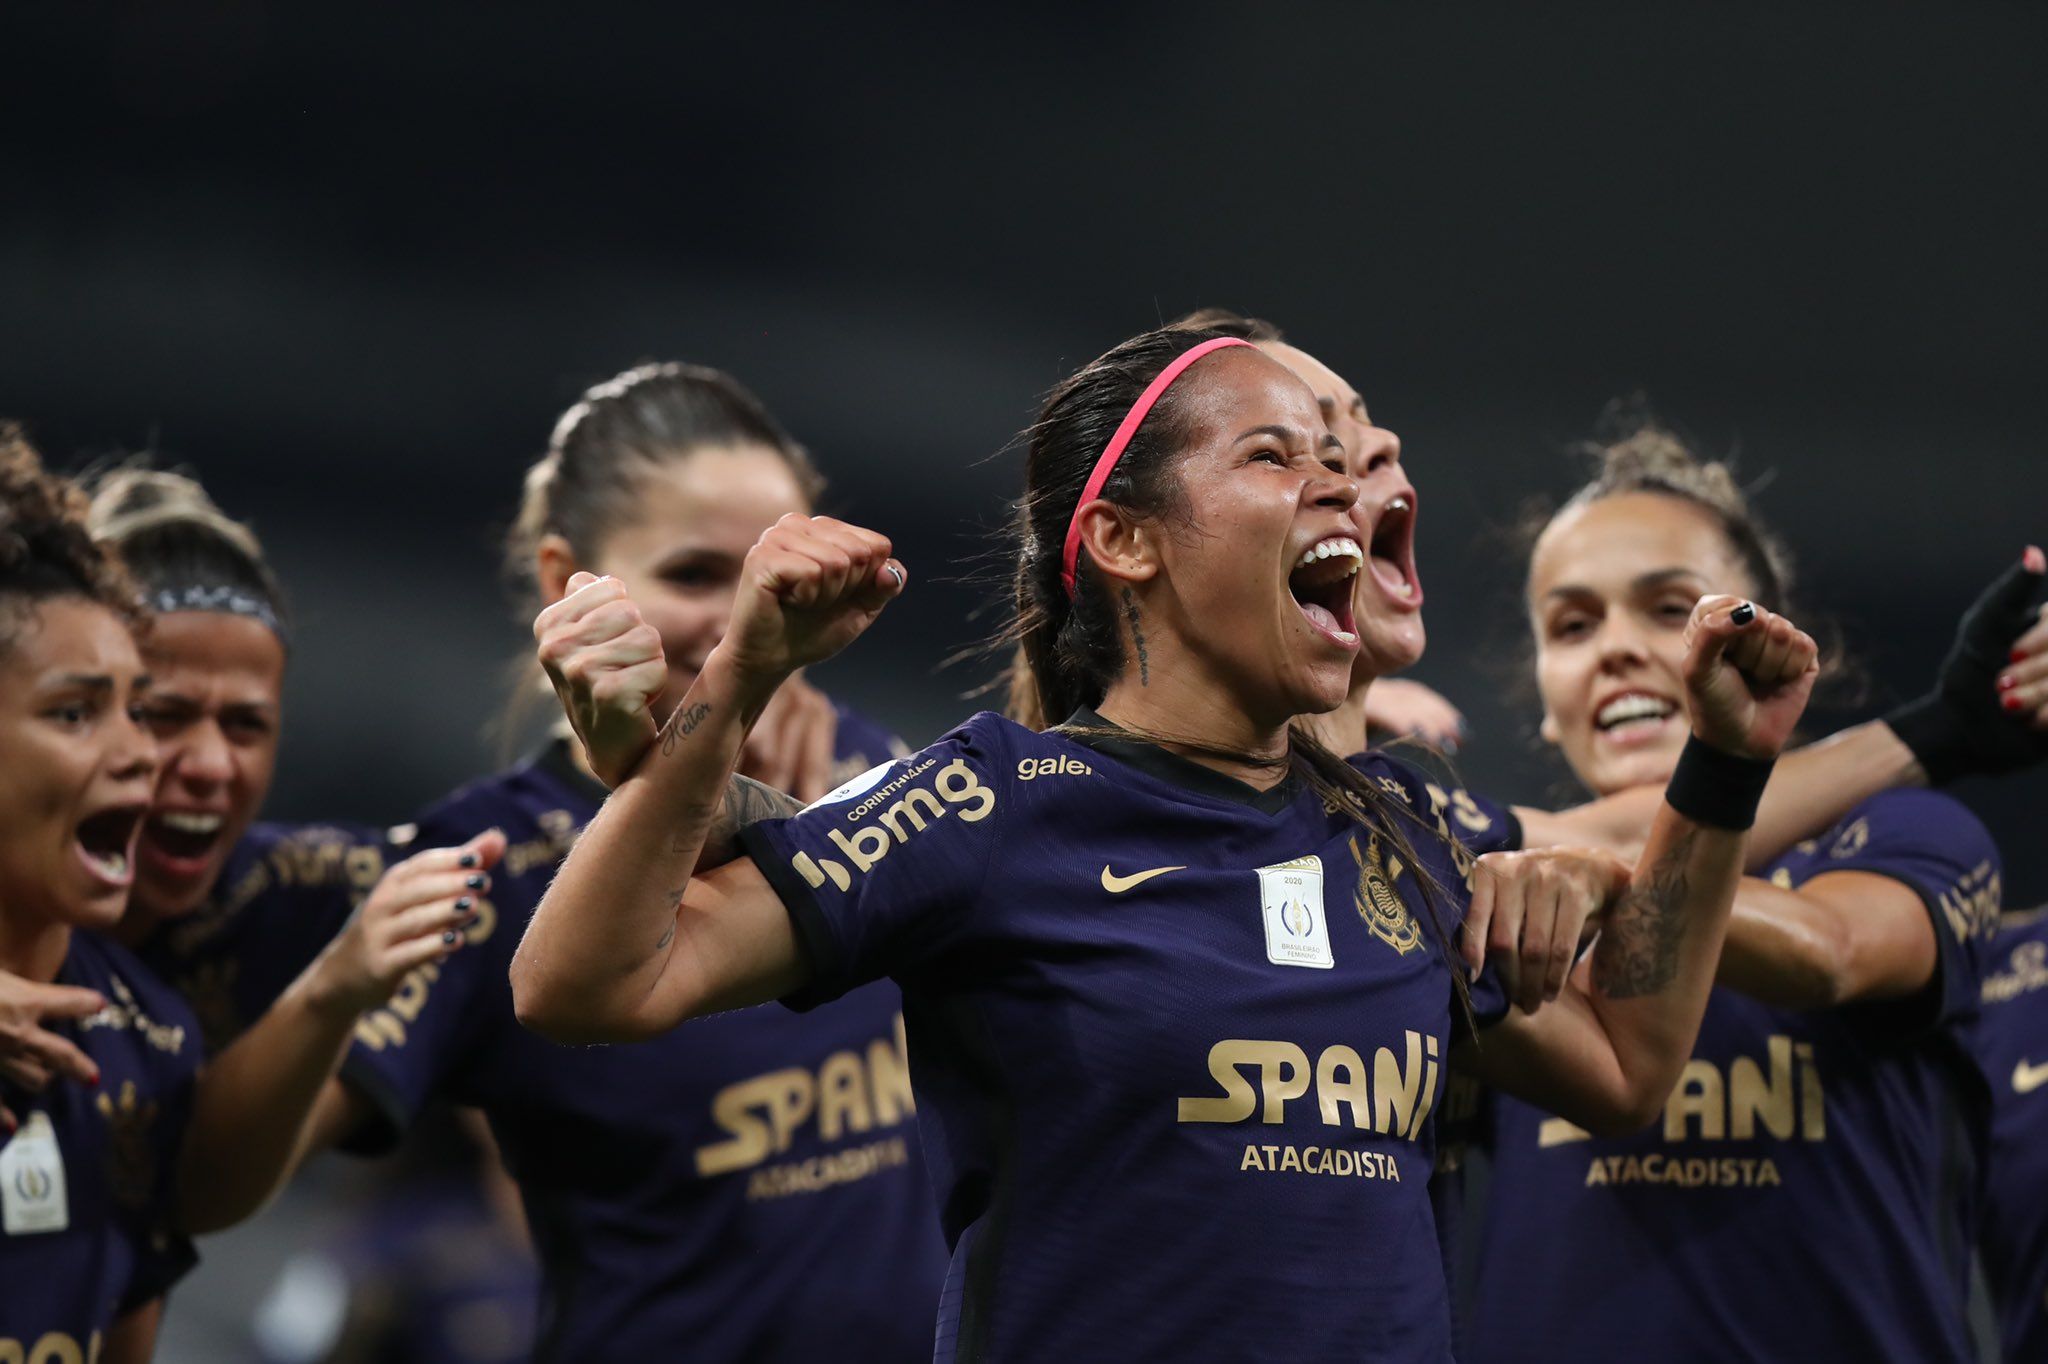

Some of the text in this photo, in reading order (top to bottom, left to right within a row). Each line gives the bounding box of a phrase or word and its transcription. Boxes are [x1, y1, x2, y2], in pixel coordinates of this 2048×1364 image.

[847, 758, 937, 822] CORINTHIANS
[827, 758, 996, 874] bmg
[1284, 876, 1303, 886] 2020
[1287, 950, 1317, 960] FEMININO
[694, 1010, 917, 1177] SPAN
[1240, 1145, 1400, 1182] ATACADISTA
[1585, 1153, 1781, 1187] ATACADISTA
